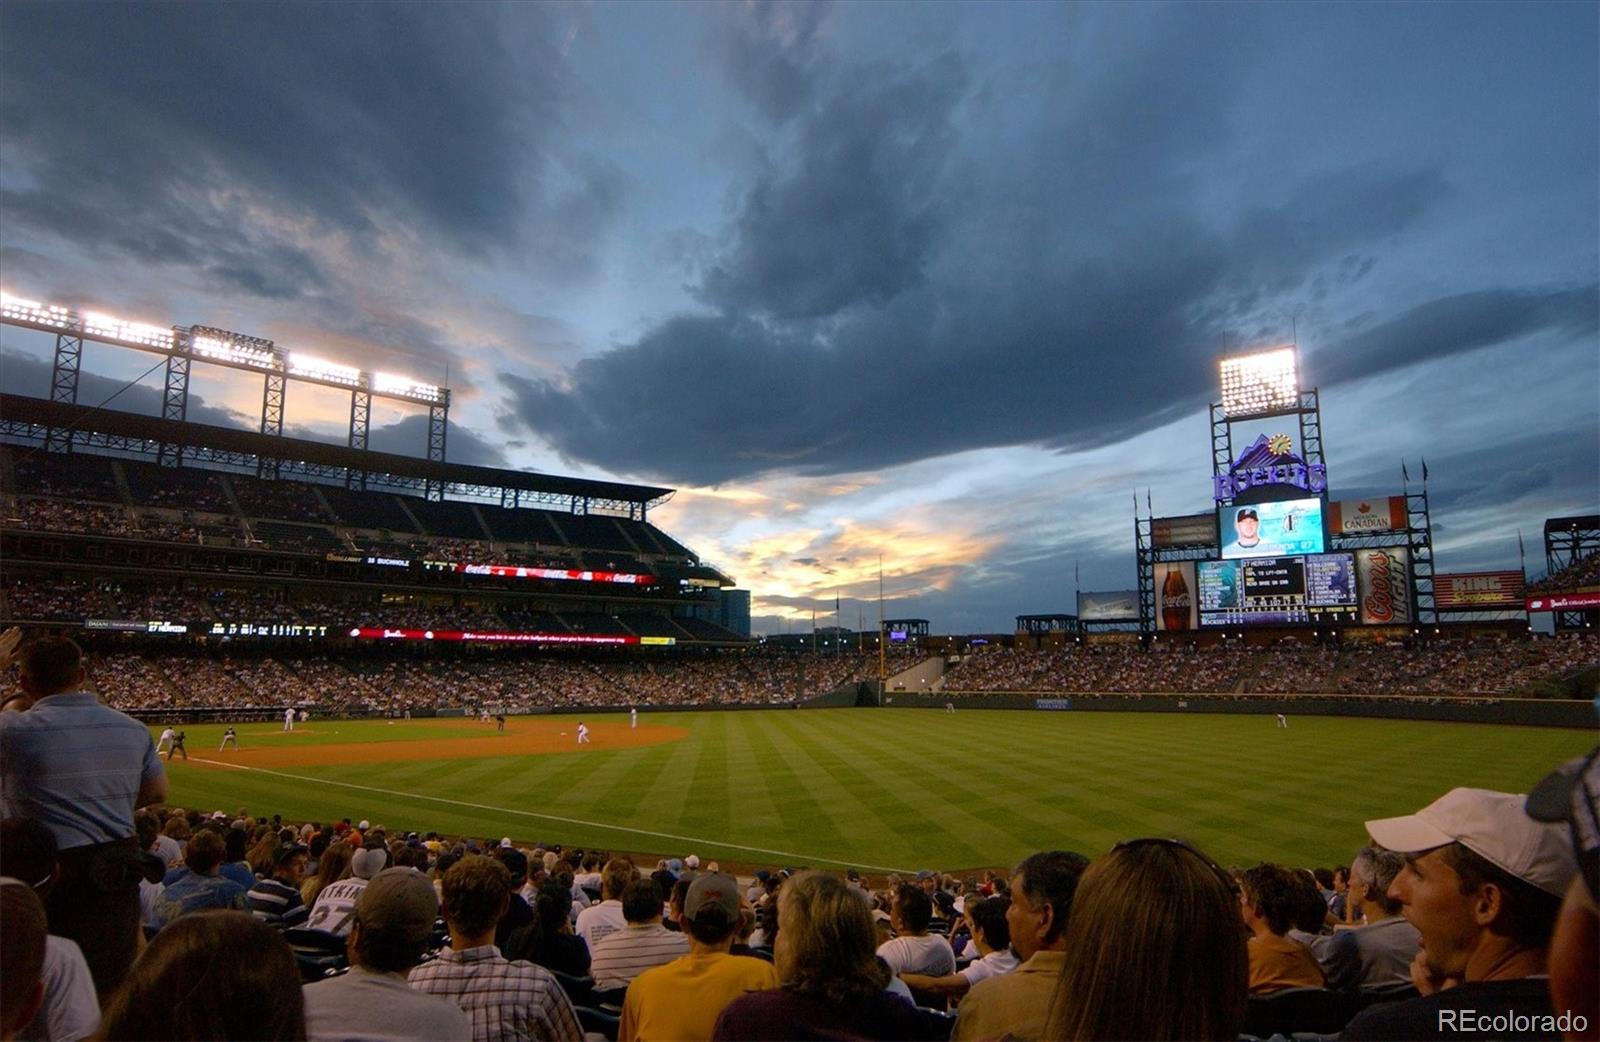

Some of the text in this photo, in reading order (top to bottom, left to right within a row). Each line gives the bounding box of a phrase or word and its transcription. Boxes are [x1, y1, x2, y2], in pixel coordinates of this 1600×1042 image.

[1212, 464, 1328, 499] ROCKIES
[1344, 518, 1388, 529] CANADIAN
[1366, 551, 1393, 622] Coors
[1452, 577, 1502, 591] KING
[310, 906, 358, 936] 27
